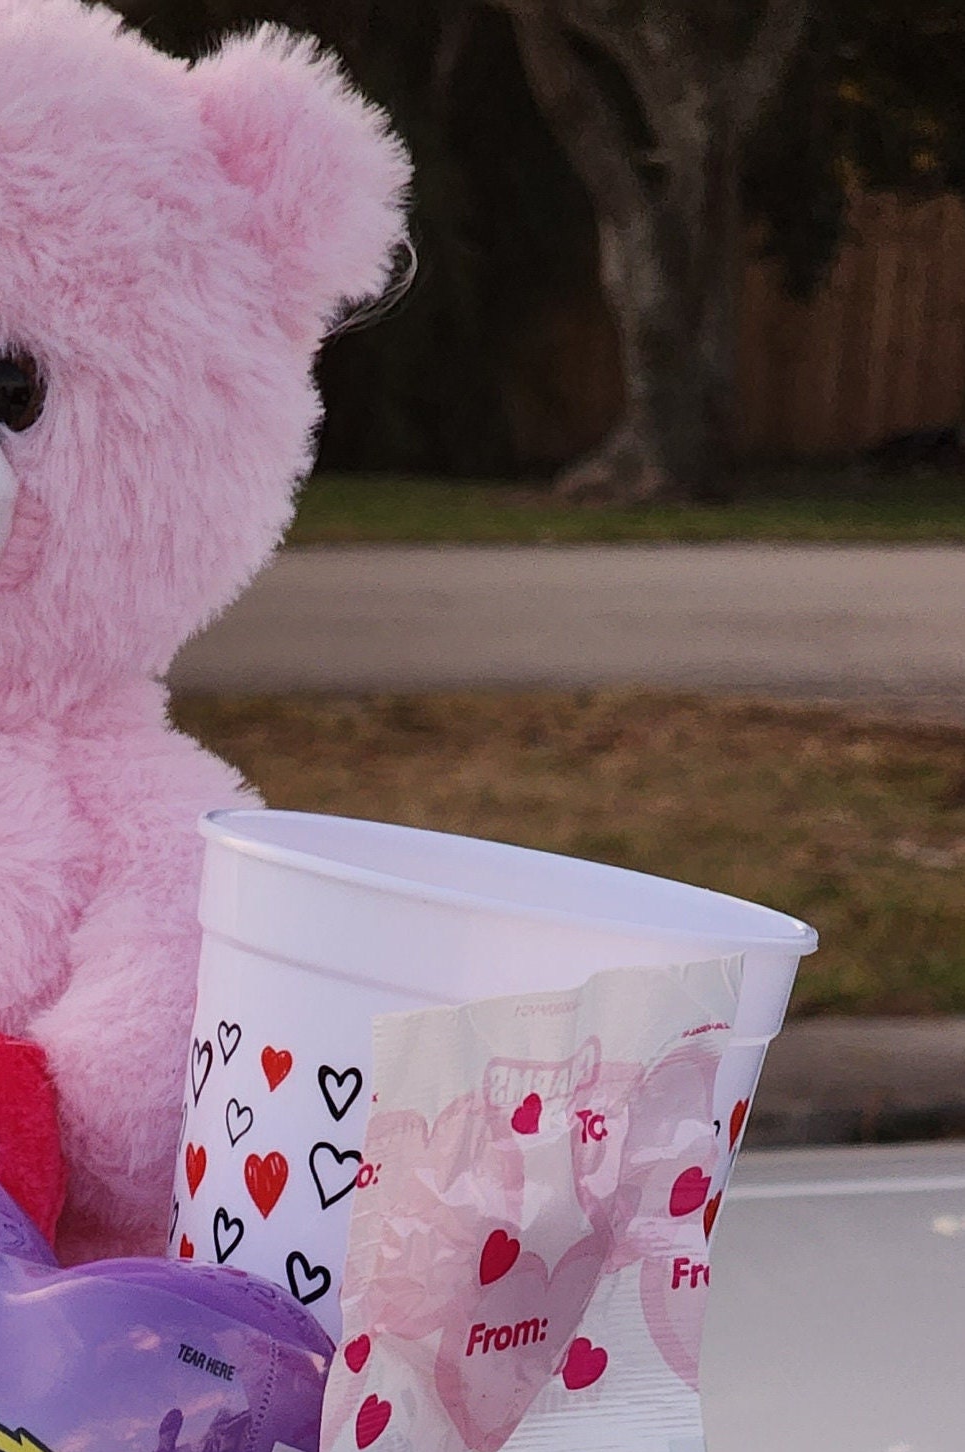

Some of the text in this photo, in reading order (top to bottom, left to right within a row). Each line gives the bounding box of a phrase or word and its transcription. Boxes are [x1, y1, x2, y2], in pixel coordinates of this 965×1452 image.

[465, 1317, 549, 1357] From:
[178, 1343, 236, 1381] TEAR HERE
